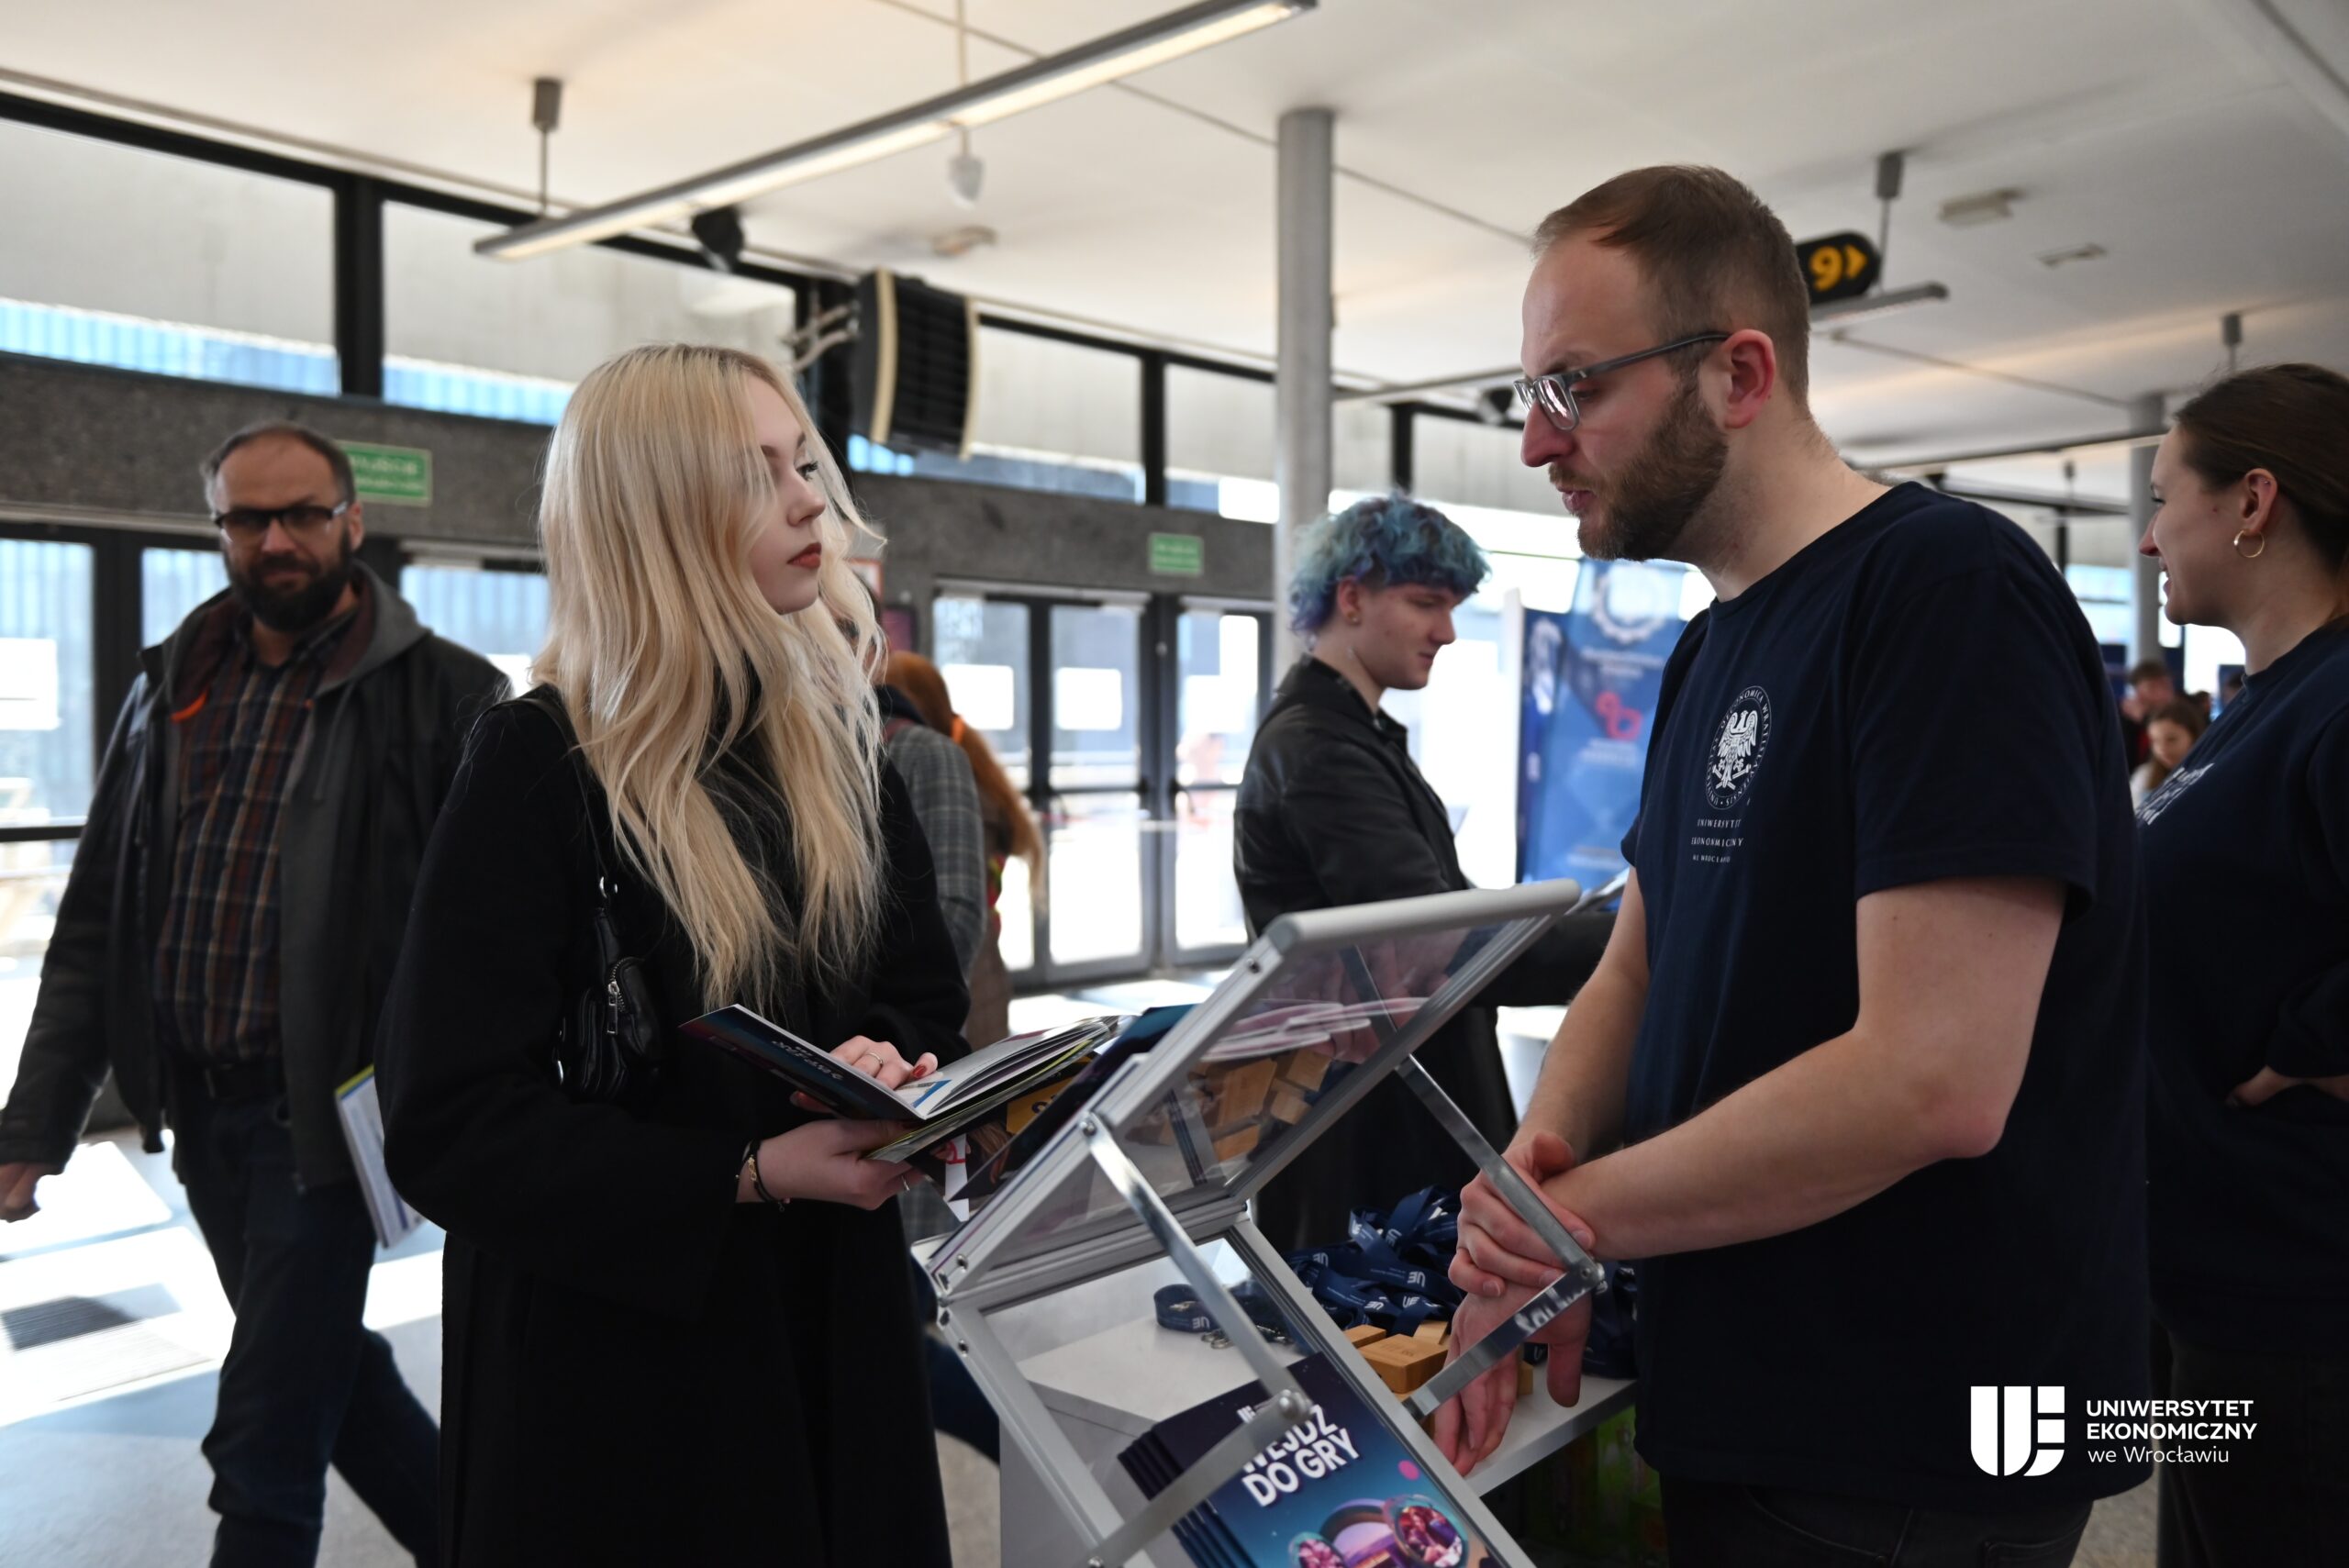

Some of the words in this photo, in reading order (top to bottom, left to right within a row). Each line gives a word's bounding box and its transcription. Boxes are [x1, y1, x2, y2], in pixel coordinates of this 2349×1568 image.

[1809, 245, 1842, 292] 9
[1312, 1252, 1329, 1267] UE
[1407, 1271, 1426, 1287] UE
[1364, 1300, 1385, 1310] UE
[1402, 1296, 1420, 1308] UE
[1193, 1317, 1210, 1329] UE
[1241, 1462, 1299, 1507] DO
[1295, 1428, 1360, 1479] GRY
